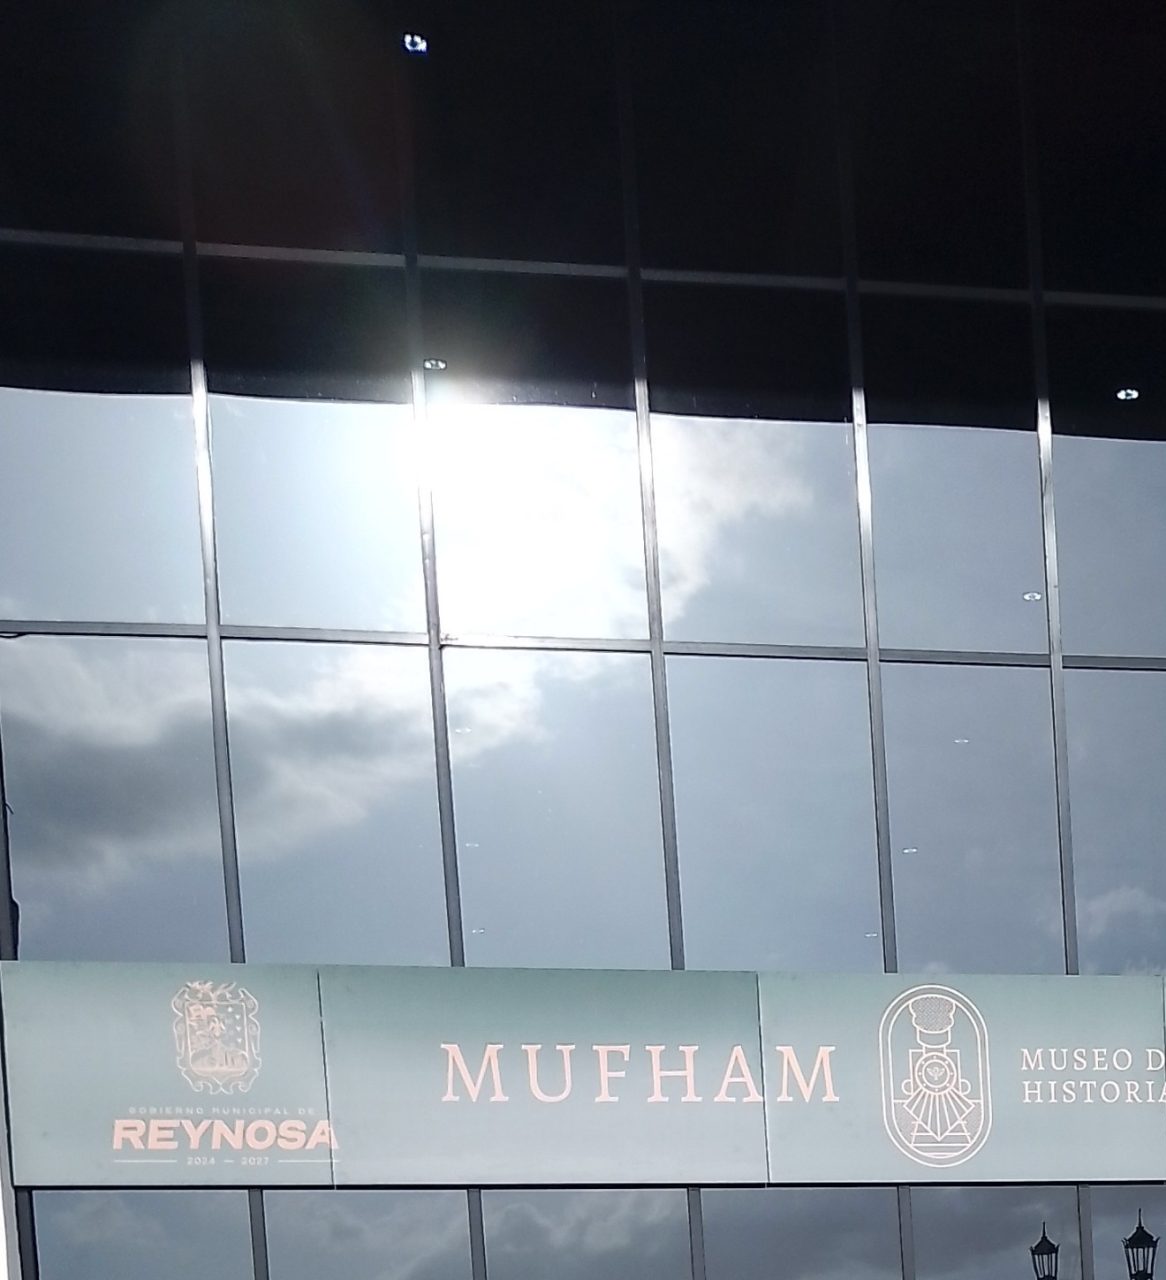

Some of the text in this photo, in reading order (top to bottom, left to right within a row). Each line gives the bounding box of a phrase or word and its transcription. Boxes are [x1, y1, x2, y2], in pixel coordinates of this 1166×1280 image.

[1020, 1047, 1133, 1071] MUSEO
[440, 1042, 840, 1103] MUFHAM
[128, 1106, 316, 1116] GOBIERNO MUNICIPAL DE
[112, 1118, 340, 1150] REYNOSA
[186, 1156, 270, 1166] 2024 2027
